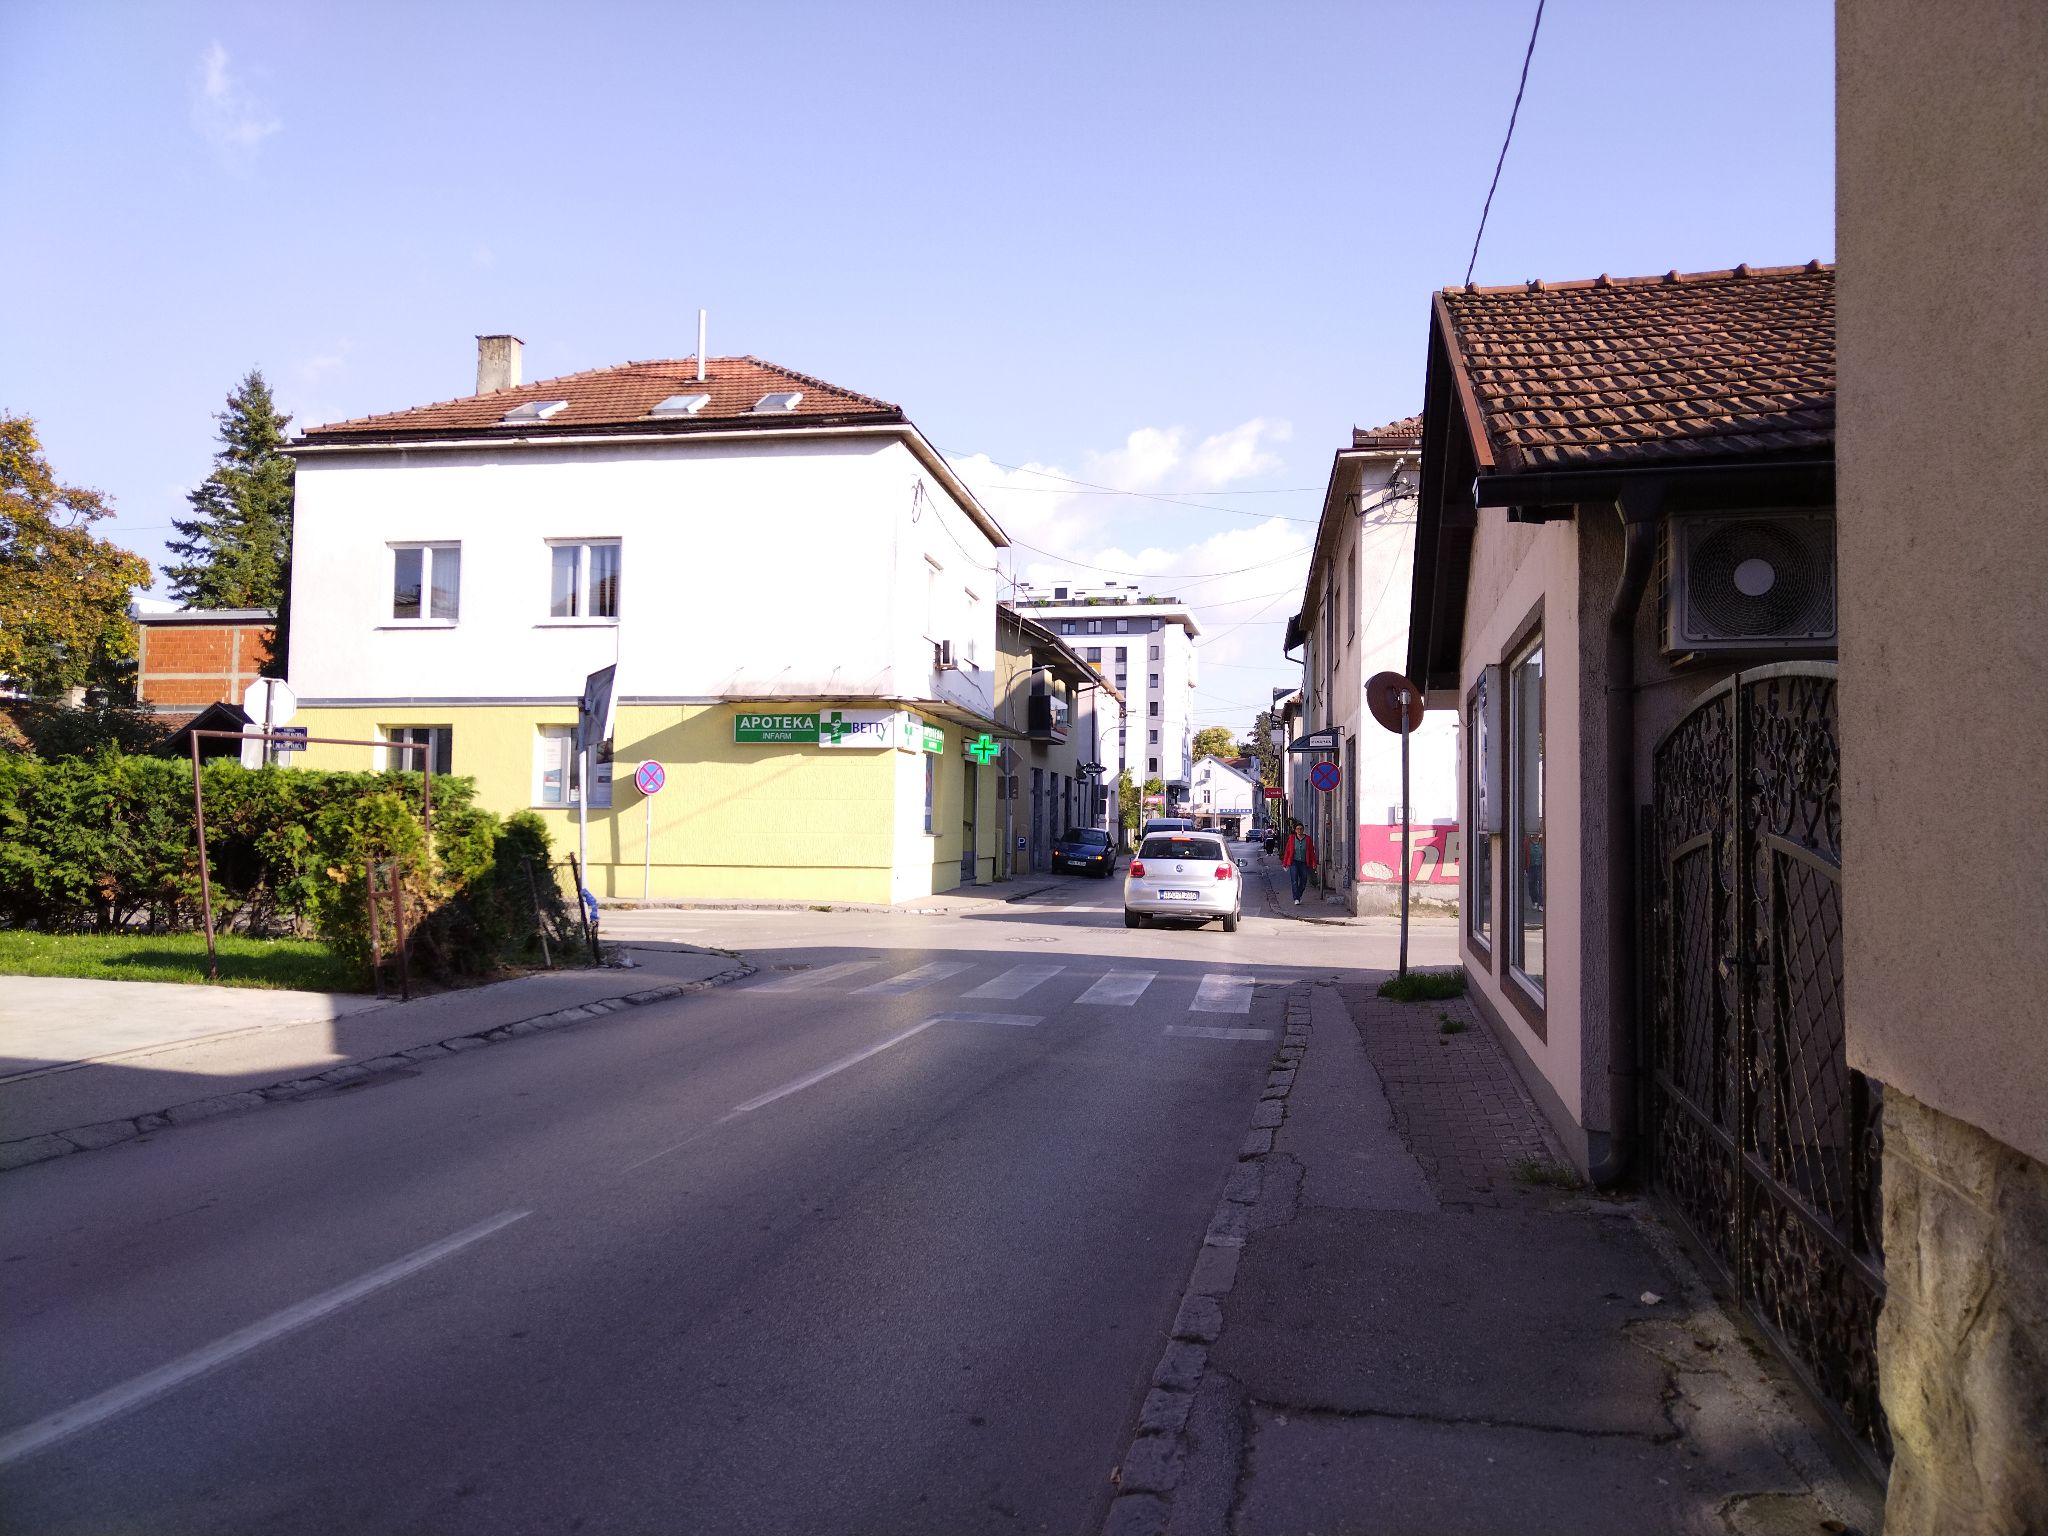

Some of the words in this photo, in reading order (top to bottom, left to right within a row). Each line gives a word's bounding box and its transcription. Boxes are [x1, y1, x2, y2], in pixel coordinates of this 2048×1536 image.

[740, 716, 814, 729] APOTEKA
[762, 732, 792, 740] INFARM
[852, 722, 886, 741] BETTY
